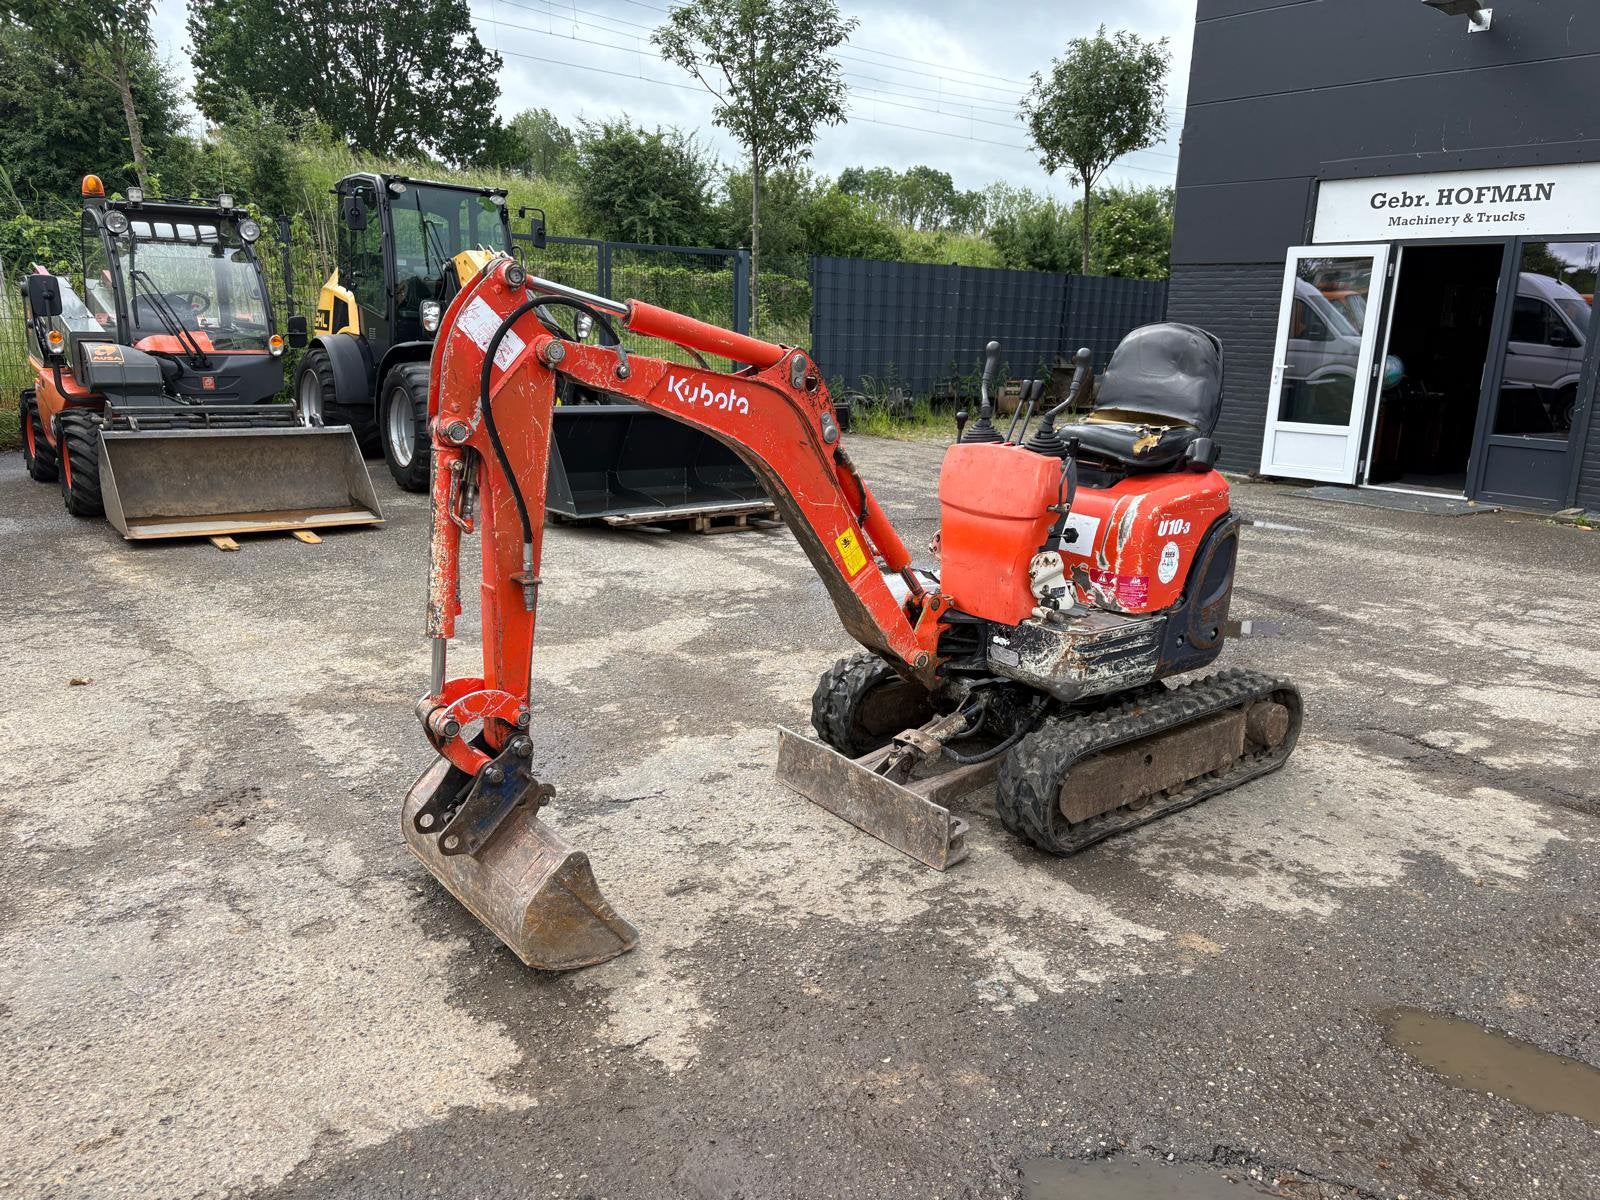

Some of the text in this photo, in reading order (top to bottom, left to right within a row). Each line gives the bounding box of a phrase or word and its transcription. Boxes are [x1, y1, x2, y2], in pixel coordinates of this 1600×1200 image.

[1370, 182, 1556, 210] Gebr. HOFMAN
[1387, 210, 1526, 227] Machinery & Trucks
[667, 375, 749, 415] Kubota
[1157, 518, 1191, 537] U10-3
